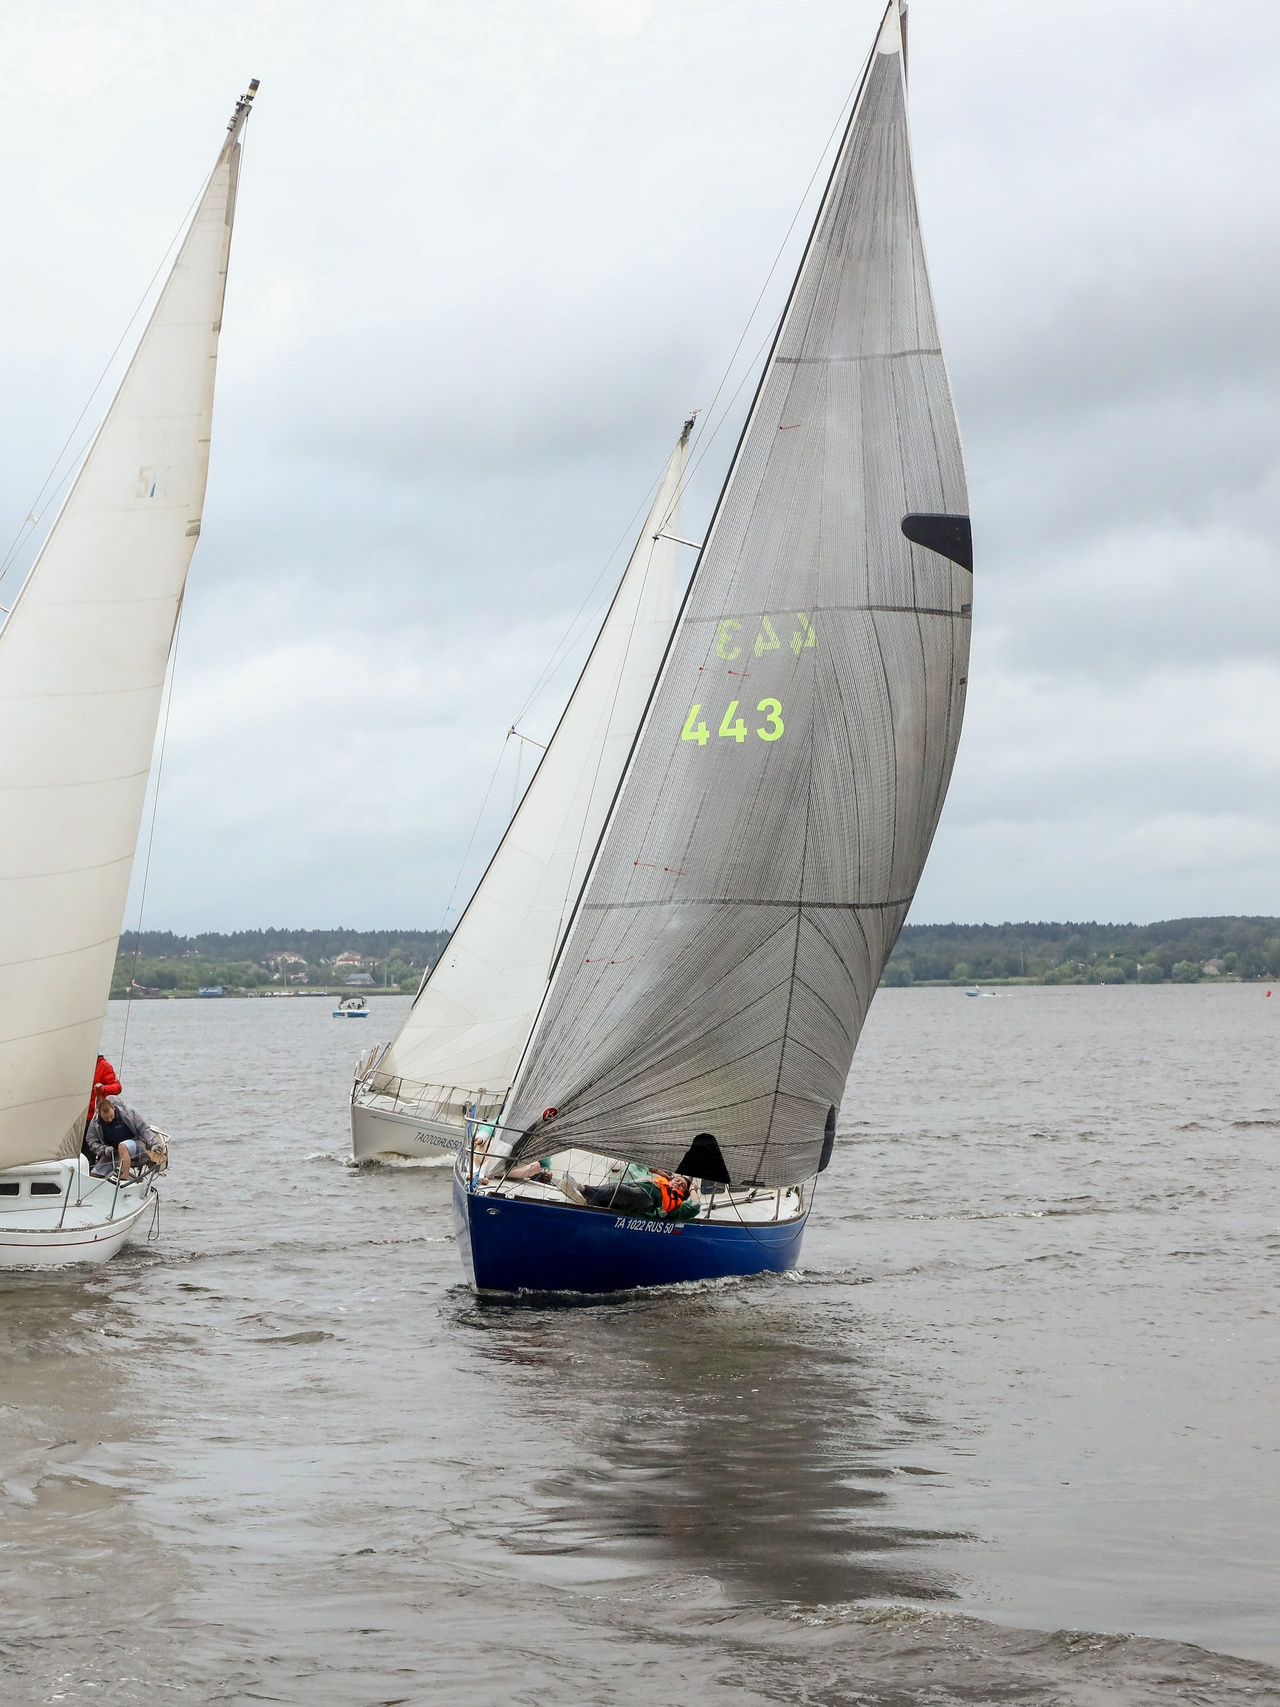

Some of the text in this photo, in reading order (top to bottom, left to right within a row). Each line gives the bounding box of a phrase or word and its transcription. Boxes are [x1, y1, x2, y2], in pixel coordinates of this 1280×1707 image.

[681, 697, 785, 746] 443
[614, 1217, 675, 1234] TA 1022 RUS 50
